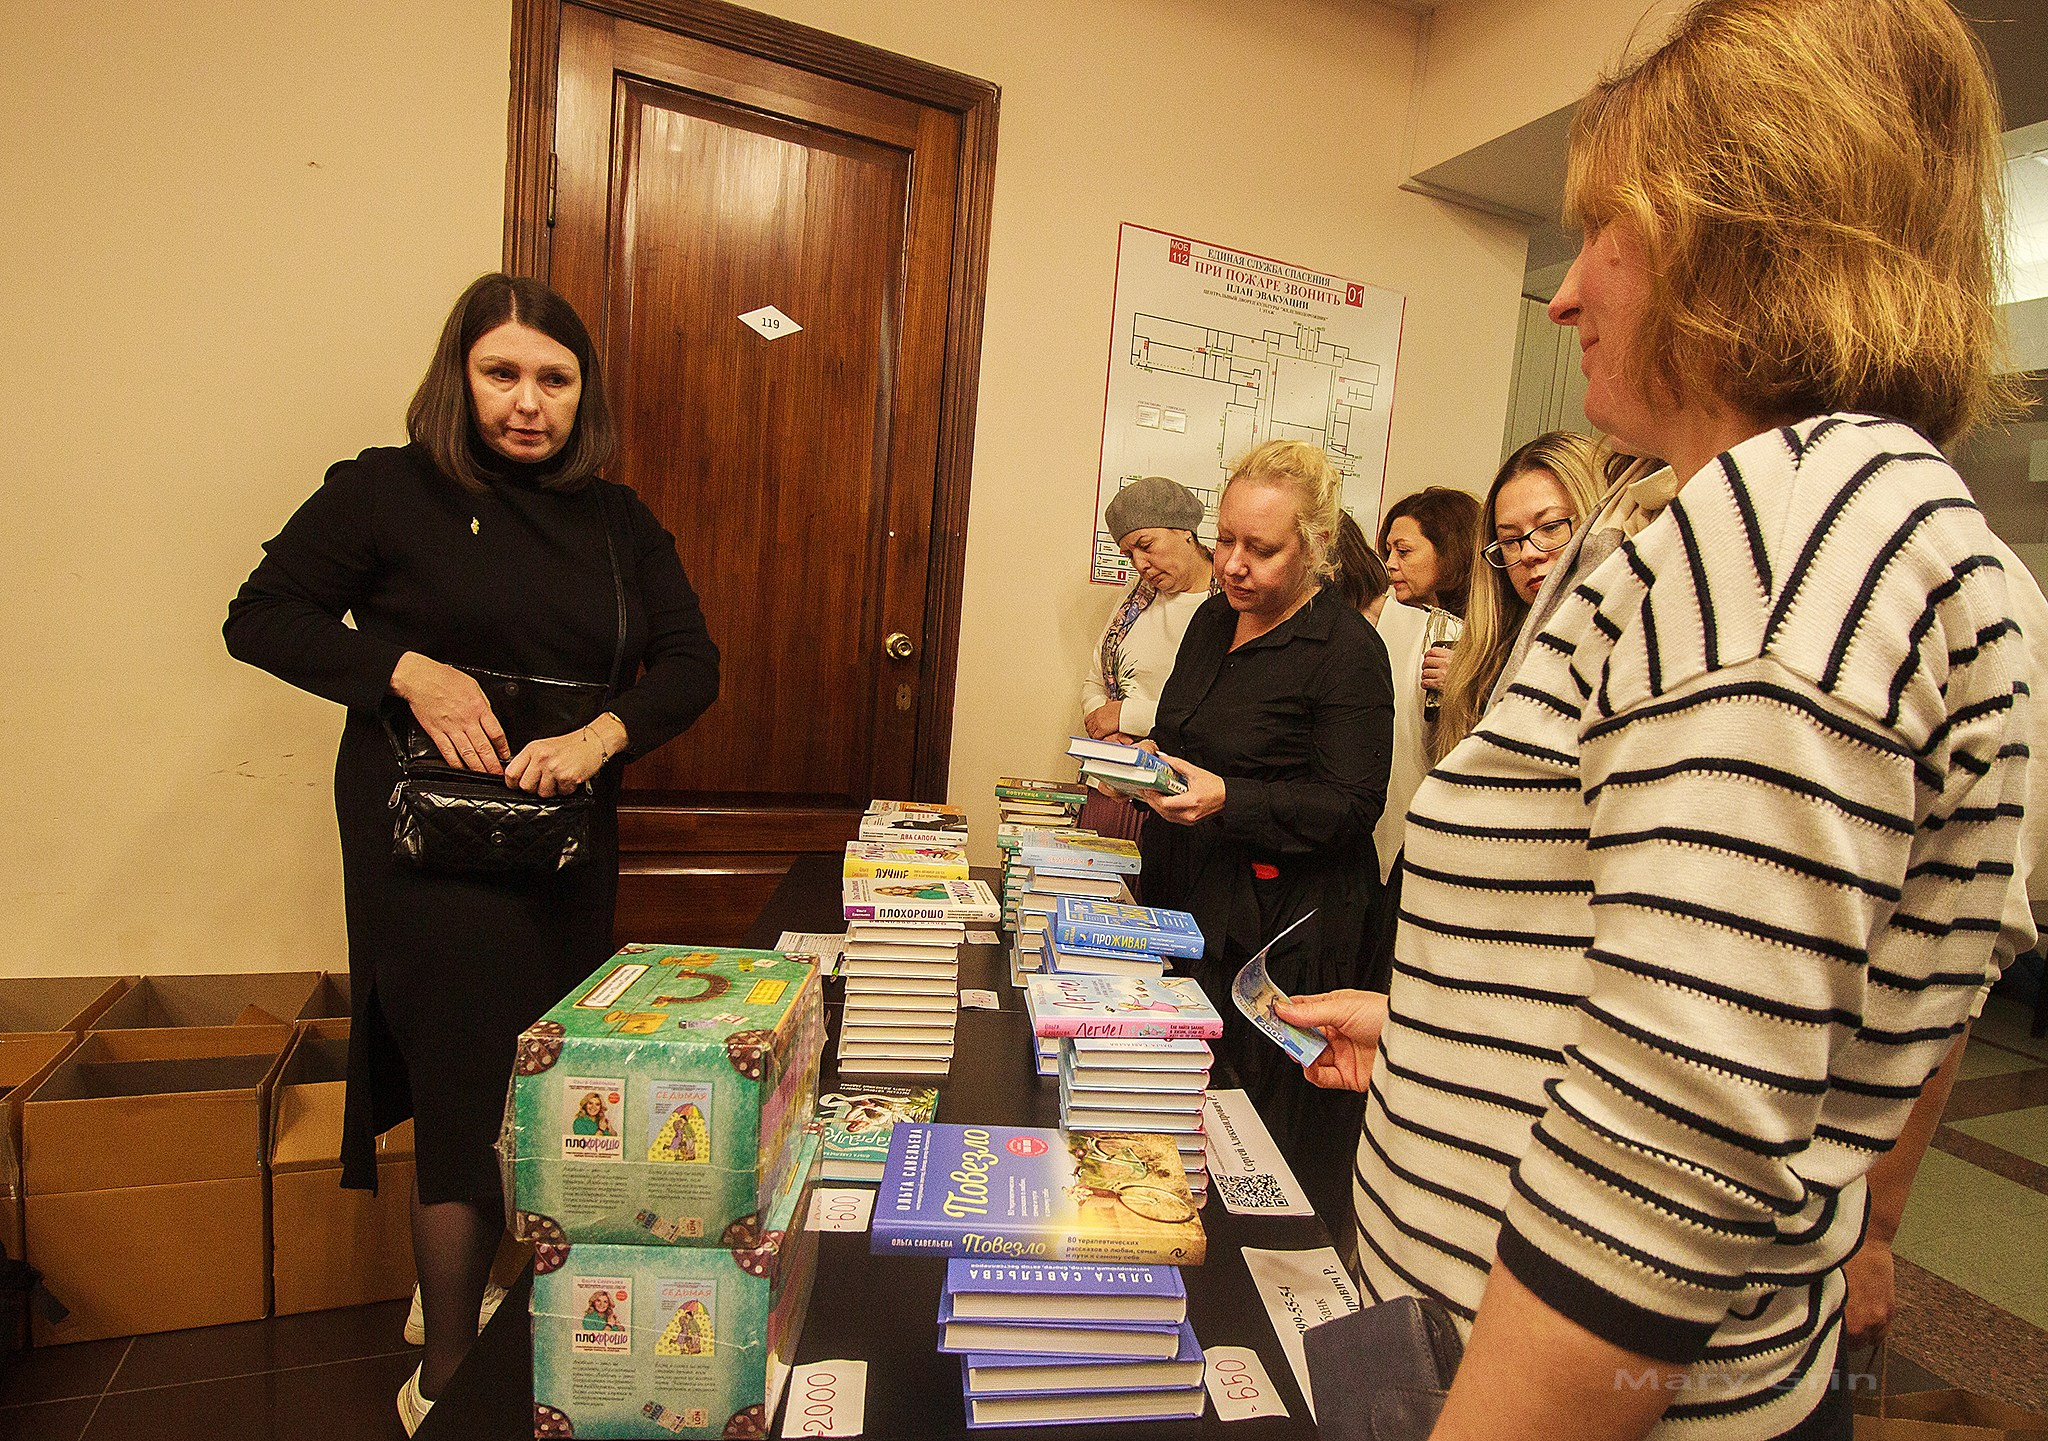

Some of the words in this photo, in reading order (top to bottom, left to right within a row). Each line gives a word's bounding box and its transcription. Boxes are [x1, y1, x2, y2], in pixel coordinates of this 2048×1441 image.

[1170, 240, 1189, 252] МОБ
[1172, 252, 1189, 265] 112
[1208, 249, 1245, 266] ЕДИНАЯ
[1246, 258, 1283, 275] СЛУЖБА
[1284, 268, 1331, 287] СПАСЕНИЯ
[1195, 261, 1222, 278] ПРИ
[1226, 269, 1281, 292] ПОЖАРЕ
[1284, 282, 1341, 306] ЗВОНИТЬ
[1226, 284, 1254, 298] ПЛАН
[1255, 290, 1309, 310] ЭВАКУАЦИИ
[1347, 287, 1364, 304] 01
[762, 317, 780, 329] 119
[913, 834, 937, 842] САПОГА
[879, 908, 944, 919] ПЛОХОРОШО
[1092, 933, 1147, 950] ПРОЖИВАЯ
[1257, 1019, 1285, 1043] 2000
[902, 1129, 923, 1177] САВЕЛЬЕВА
[1235, 1145, 1256, 1172] Сергей
[943, 1128, 999, 1218] Повезло
[896, 1181, 915, 1211] ОЛЬГА
[891, 1238, 913, 1247] ОЛЬГА
[914, 1239, 953, 1248] САВЕЛЬЕВА
[961, 1233, 1047, 1257] Повезло
[969, 1269, 1082, 1281] САВЕЛЬЕВА
[1094, 1271, 1153, 1283] ОЛЬГА
[1323, 1265, 1337, 1276] Р.
[662, 1289, 712, 1297] СЕДЬМАЯ
